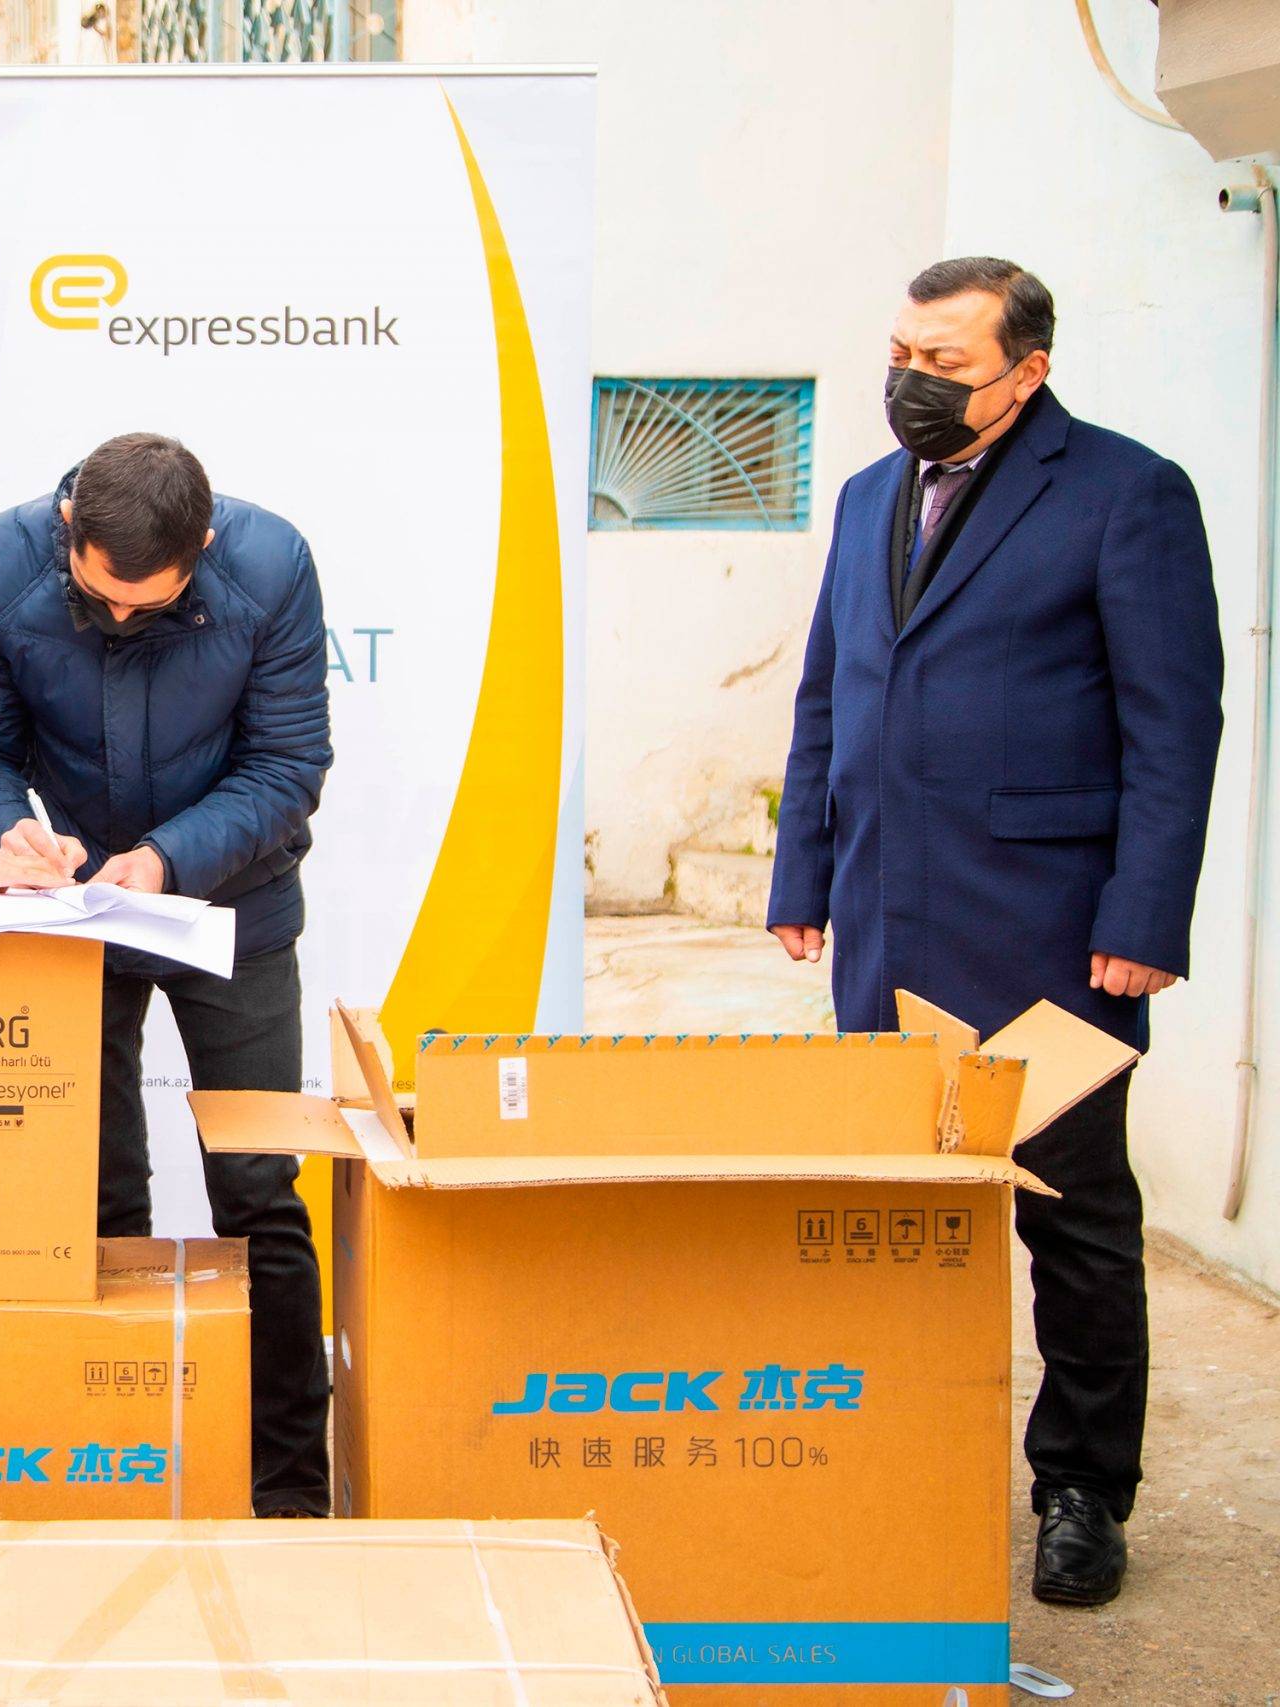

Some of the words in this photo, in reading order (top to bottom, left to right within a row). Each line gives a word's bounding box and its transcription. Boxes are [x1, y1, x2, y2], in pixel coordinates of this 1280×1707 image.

[108, 305, 400, 356] expressbank
[30, 1054, 51, 1068] Ütü
[856, 1218, 867, 1231] 6
[122, 1366, 130, 1376] 6
[738, 1364, 864, 1410] 杰克
[66, 1443, 168, 1483] 杰克
[672, 1645, 760, 1663] GLOBAL
[767, 1645, 837, 1663] SALES
